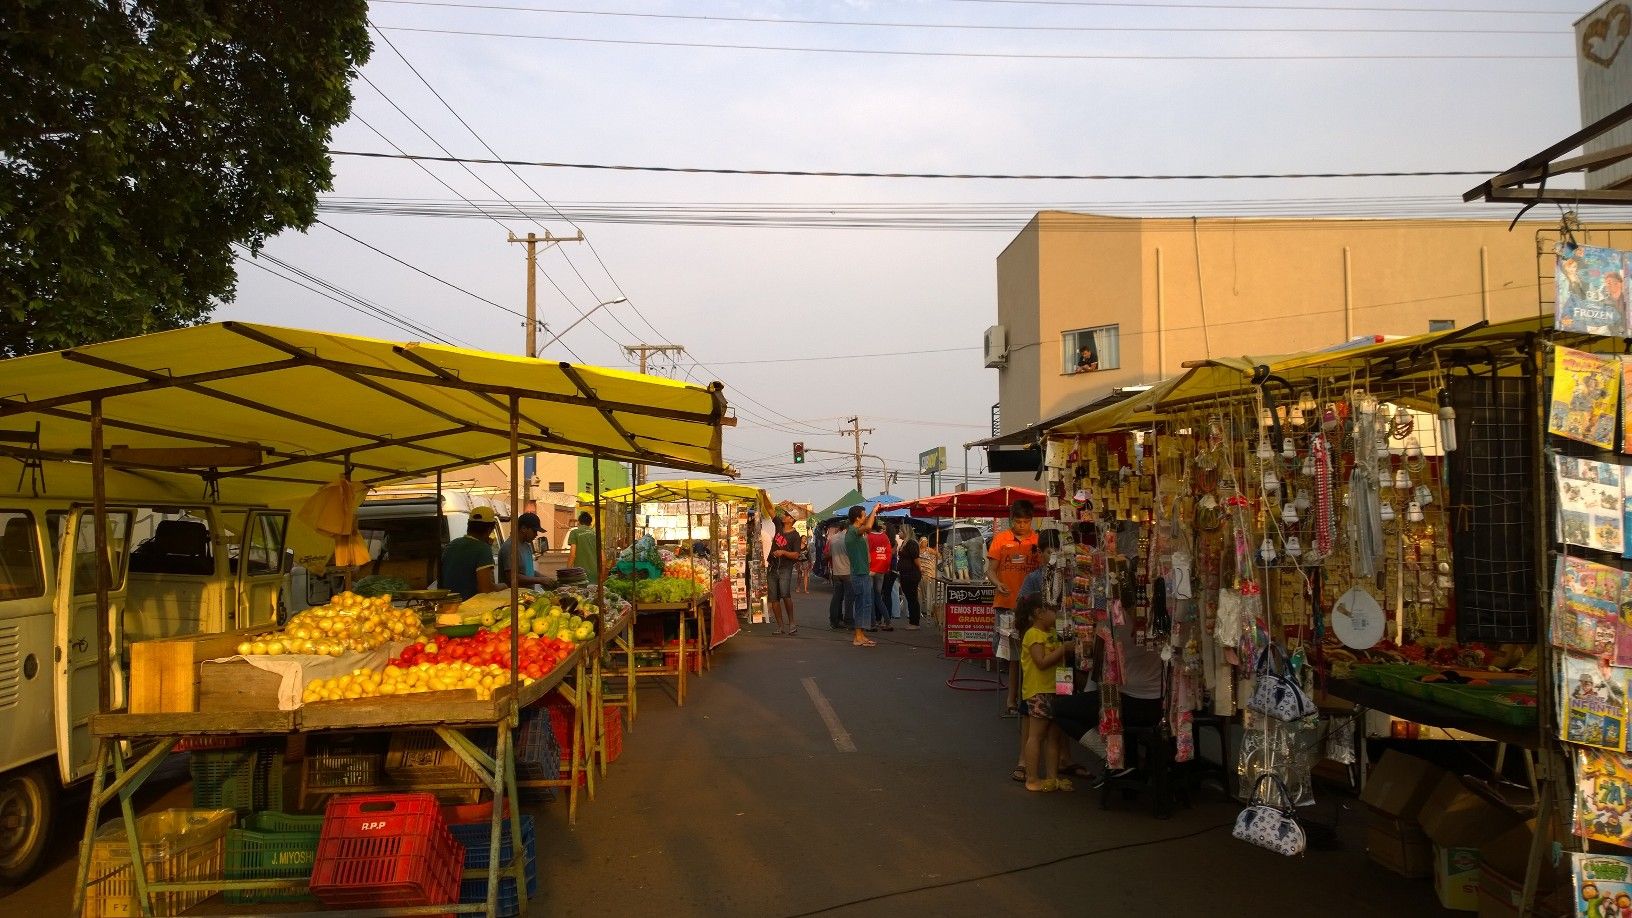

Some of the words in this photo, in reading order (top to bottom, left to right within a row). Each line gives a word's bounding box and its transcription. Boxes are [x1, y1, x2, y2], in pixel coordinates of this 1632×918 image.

[1573, 307, 1615, 320] FROZEN
[950, 606, 972, 614] TEMOS
[972, 606, 985, 615] PEN
[272, 851, 278, 865] J.
[280, 850, 314, 864] MIYOSHI
